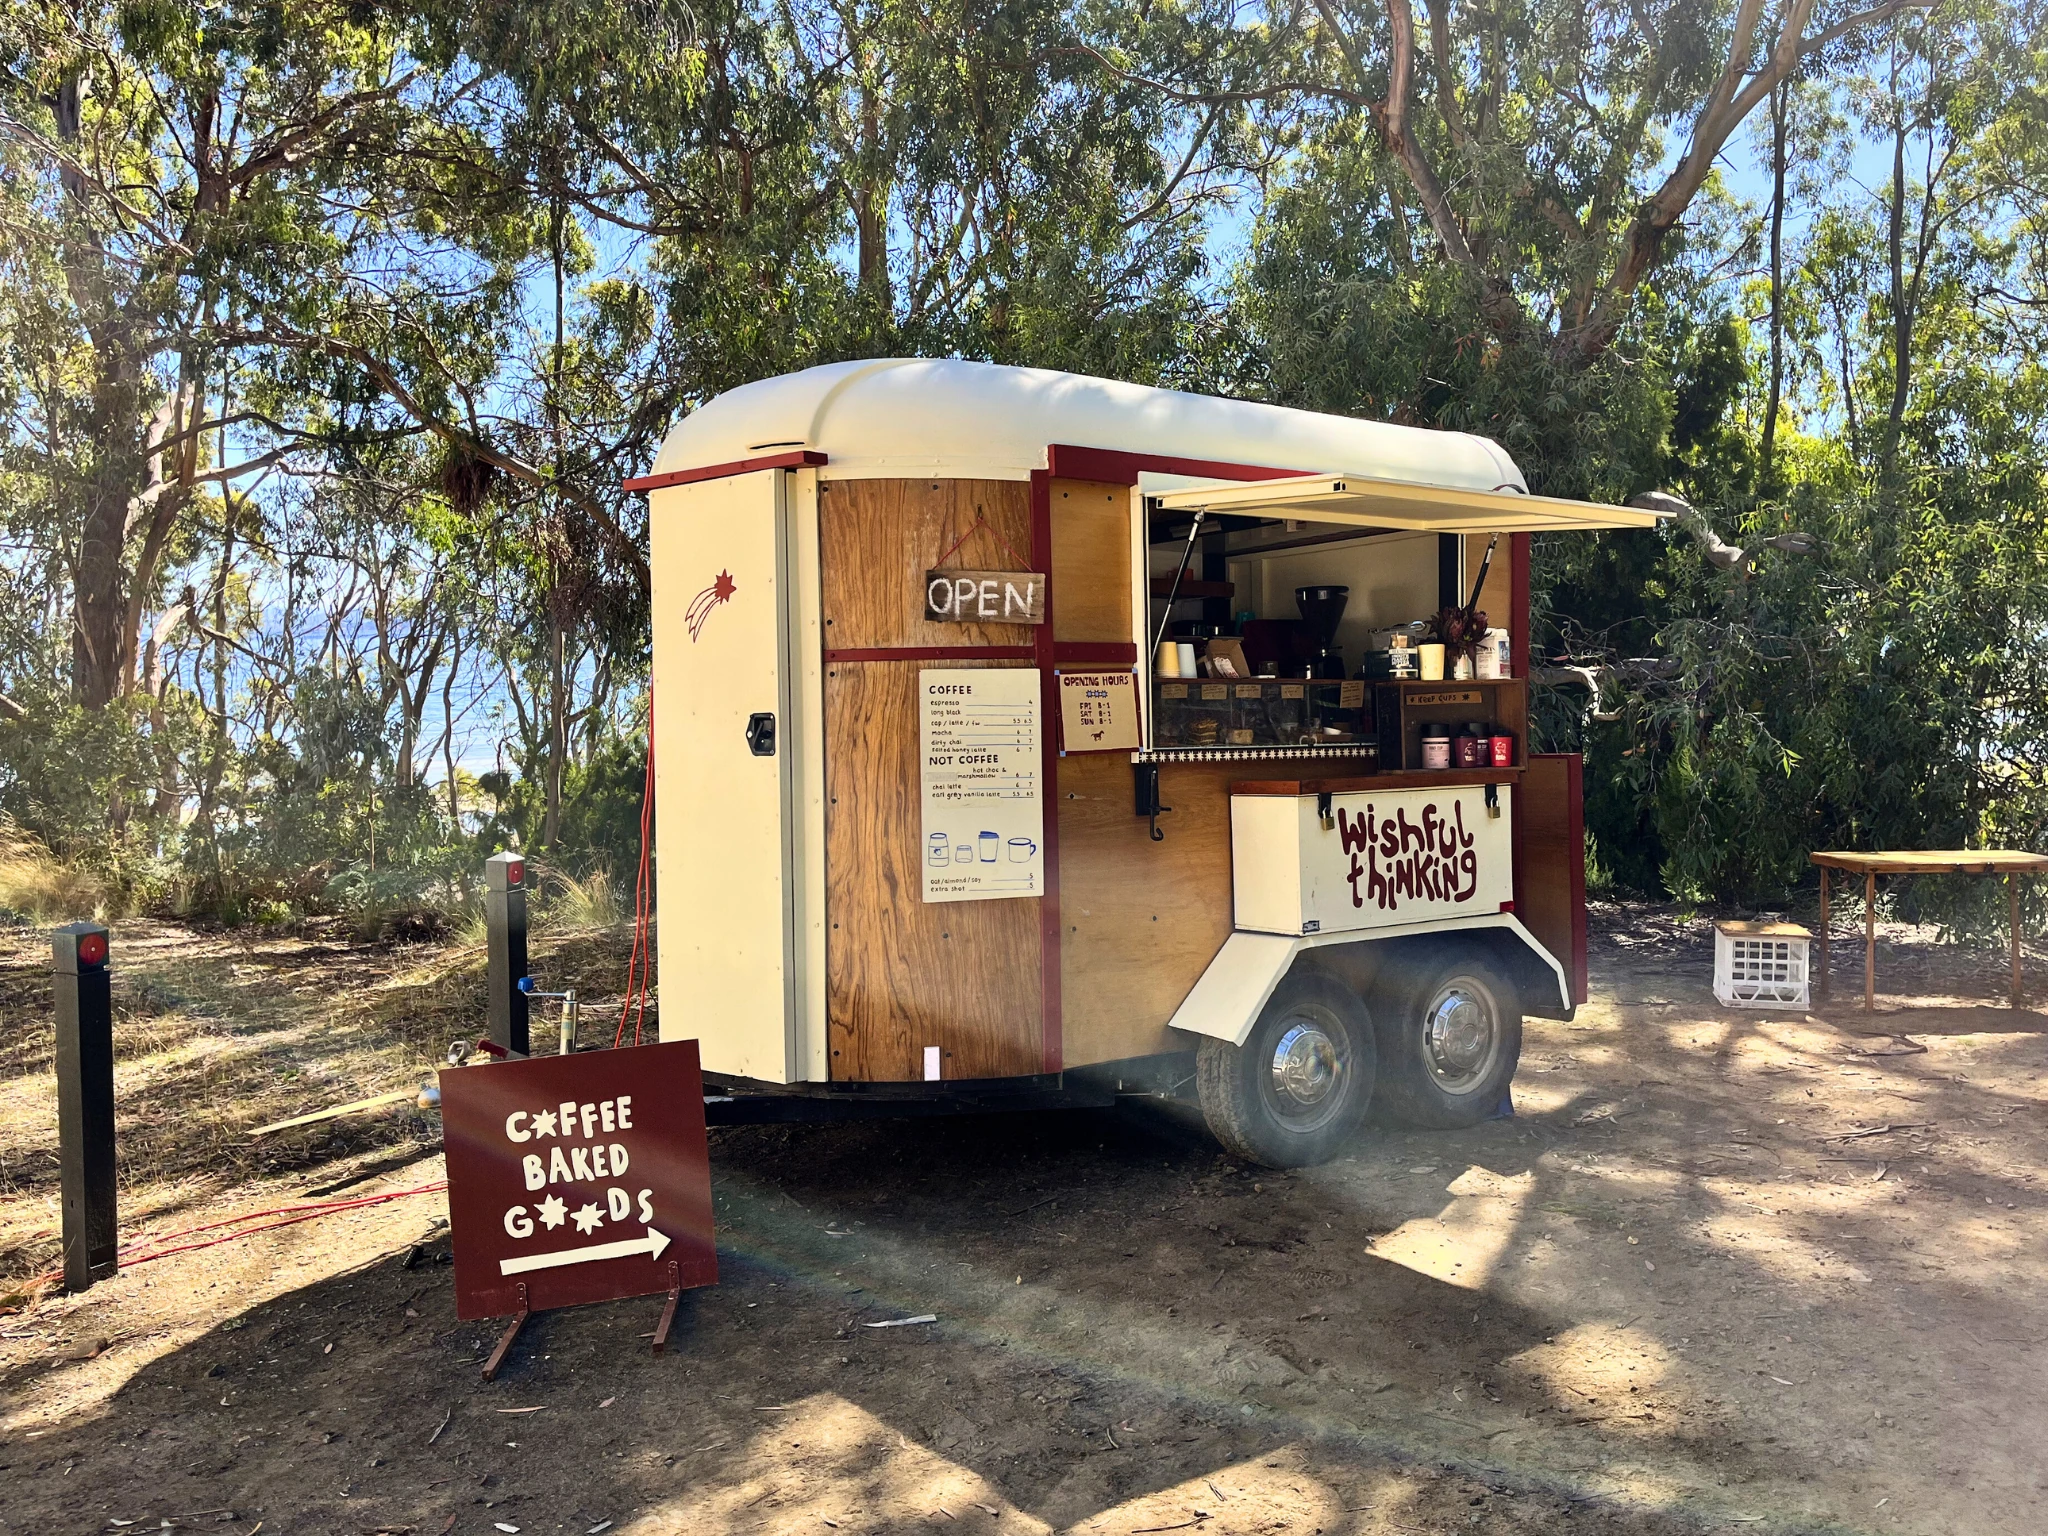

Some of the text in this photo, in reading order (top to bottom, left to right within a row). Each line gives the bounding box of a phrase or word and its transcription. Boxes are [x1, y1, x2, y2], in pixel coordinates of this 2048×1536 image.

[928, 577, 1034, 618] OPEN
[1064, 676, 1128, 686] OPENING HOURS
[929, 685, 972, 694] COFFEE
[929, 754, 999, 766] NOT COFFEE
[947, 792, 962, 800] grey
[522, 1143, 630, 1192] BAKED
